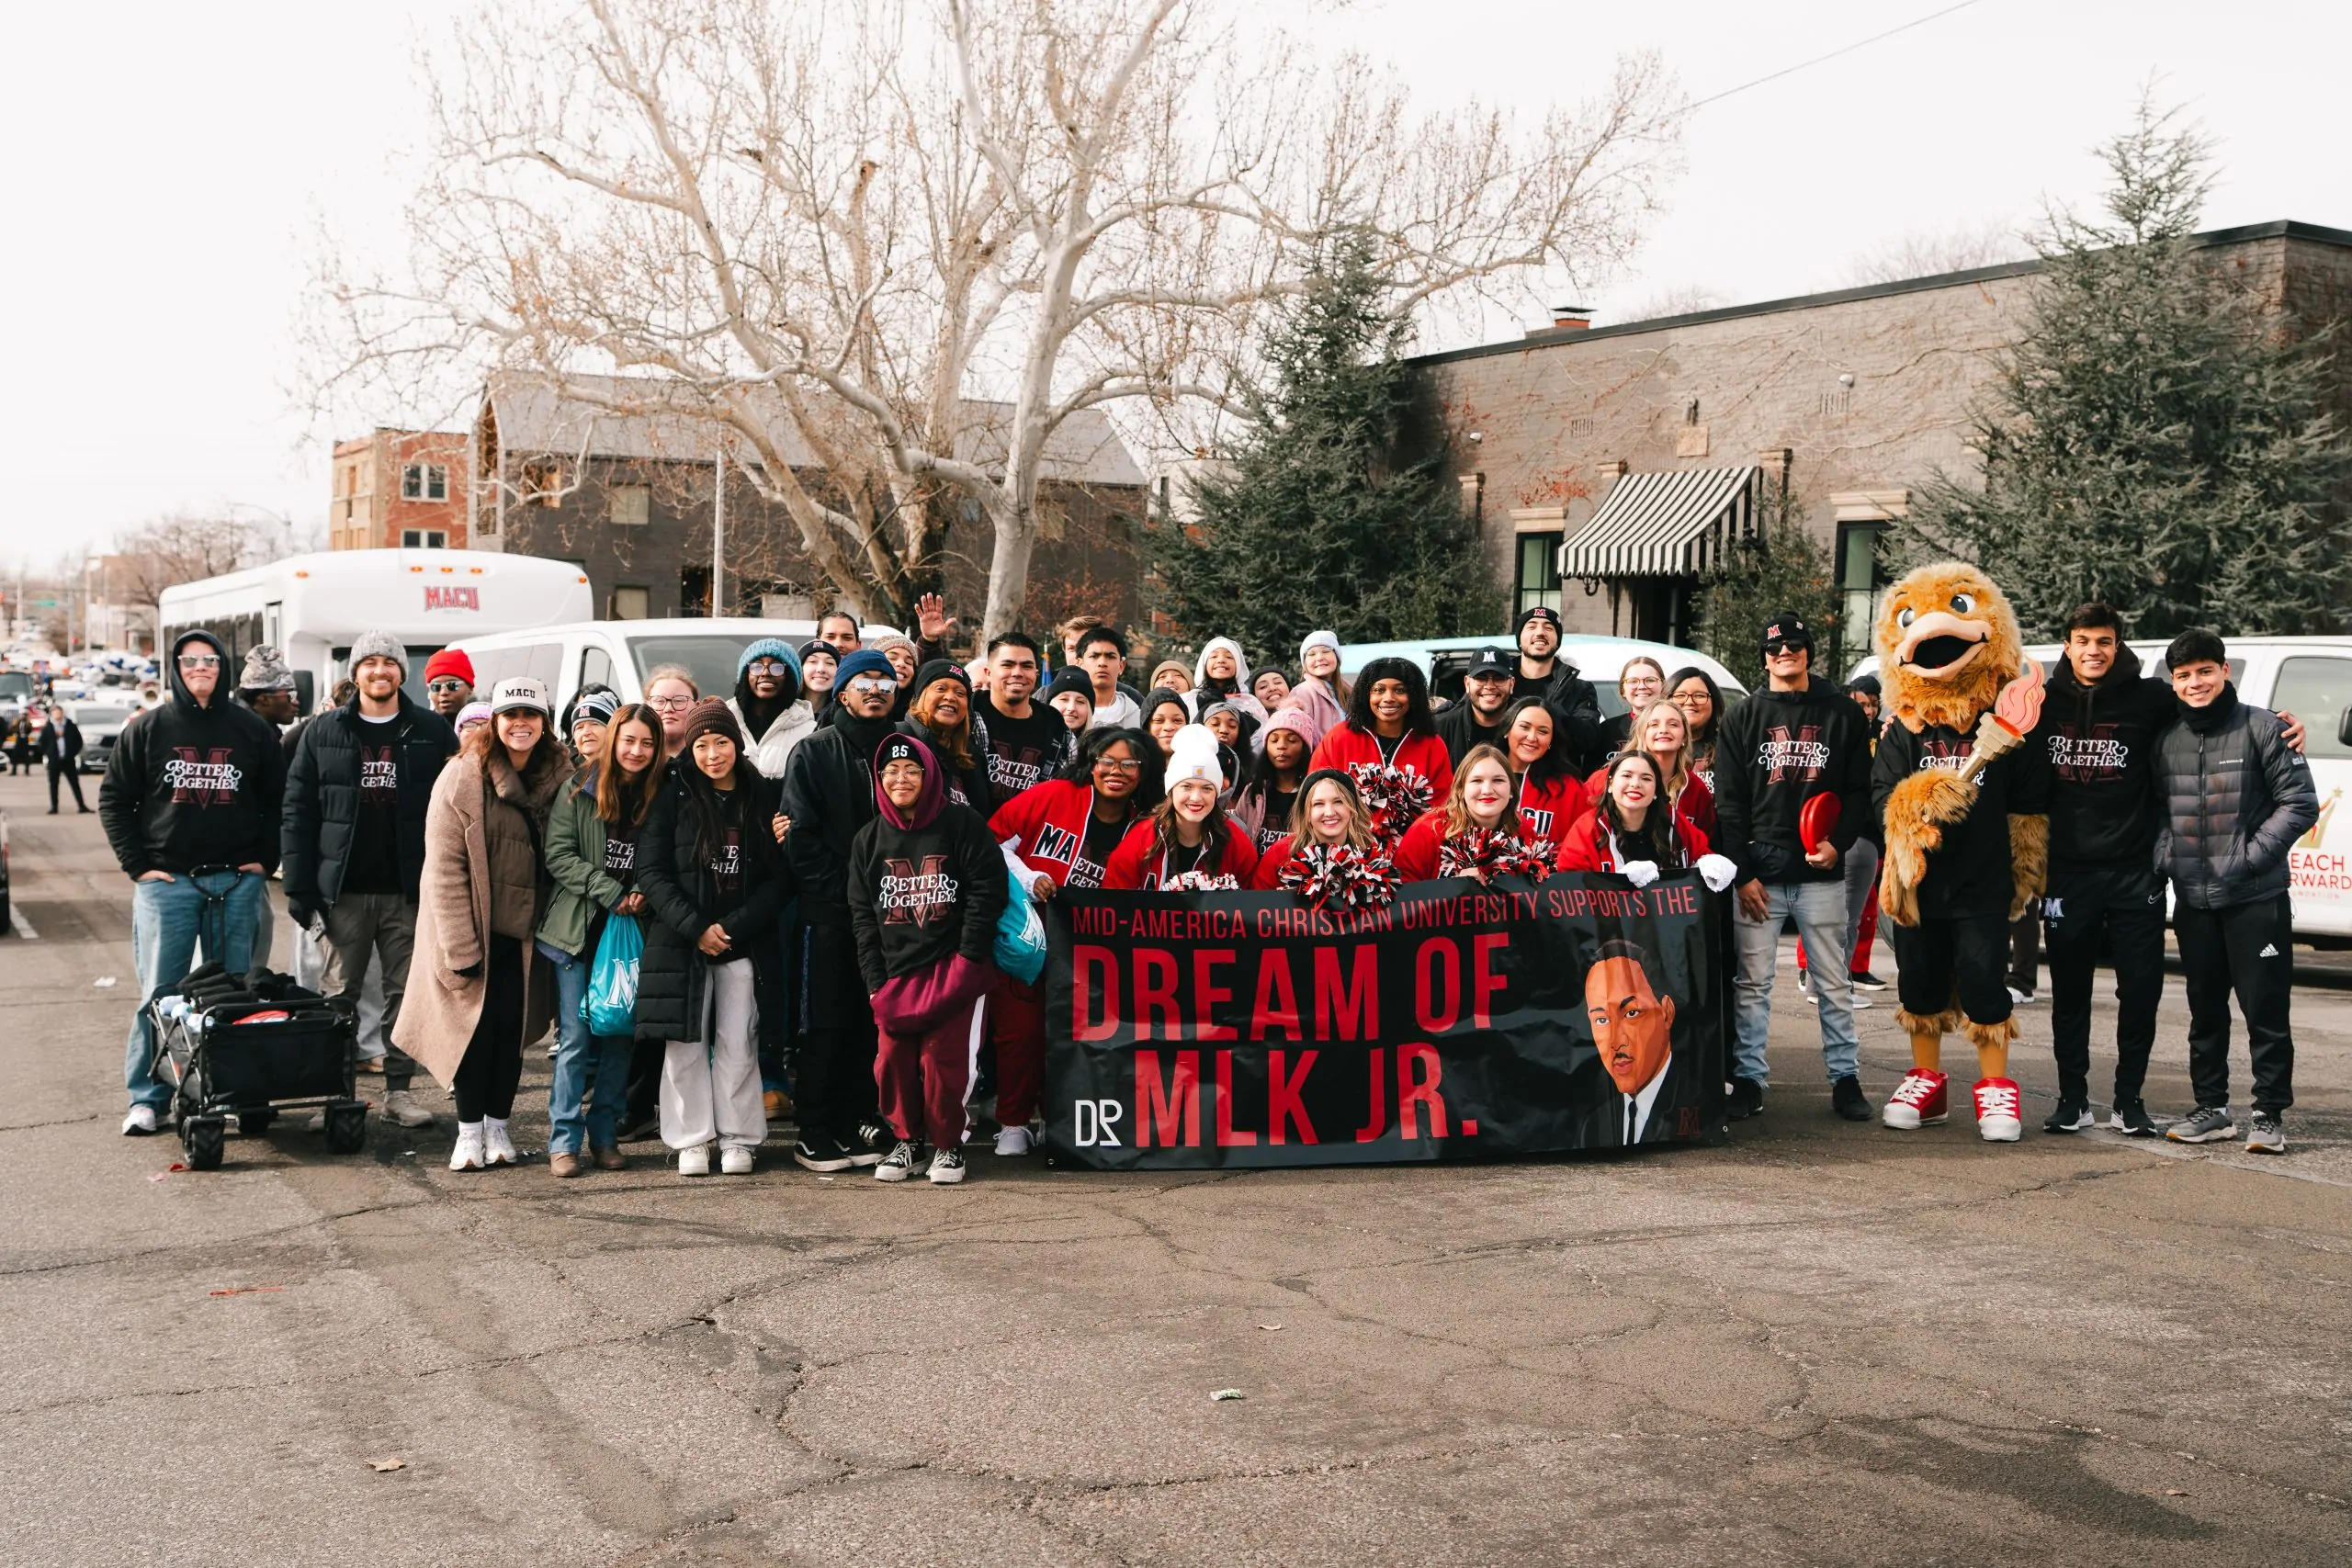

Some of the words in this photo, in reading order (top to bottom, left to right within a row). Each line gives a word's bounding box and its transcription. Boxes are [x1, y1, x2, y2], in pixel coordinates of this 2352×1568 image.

[424, 586, 479, 612] MACU
[1767, 624, 1782, 640] M
[1482, 650, 1497, 662] M
[949, 664, 964, 678] M
[505, 688, 536, 699] MACU
[579, 706, 591, 717] M
[1759, 740, 1830, 761] BETTER
[2048, 736, 2129, 756] BETTER
[1758, 753, 1827, 771] TOGETHER
[2048, 748, 2127, 768] TOGETHER
[165, 760, 243, 780] BETTER
[164, 773, 240, 792] TOGETHER
[989, 772, 1038, 790] OGETHE
[2291, 852, 2344, 872] EACH
[880, 874, 958, 897] BETTER
[2290, 872, 2352, 890] RWARD
[879, 886, 956, 908] TOGETHER
[1072, 906, 1247, 939] MID-AMERICA
[1257, 907, 1393, 938] CHRISTIAN
[1400, 891, 1539, 930] UNIVERSITY
[1548, 888, 1647, 918] SUPPORTS
[1651, 886, 1698, 916] THE
[2043, 897, 2064, 919] M
[1072, 942, 1379, 1042] DREAM
[1415, 932, 1510, 1033] OF
[1135, 1049, 1320, 1148] MLK
[1355, 1042, 1478, 1144] JR.
